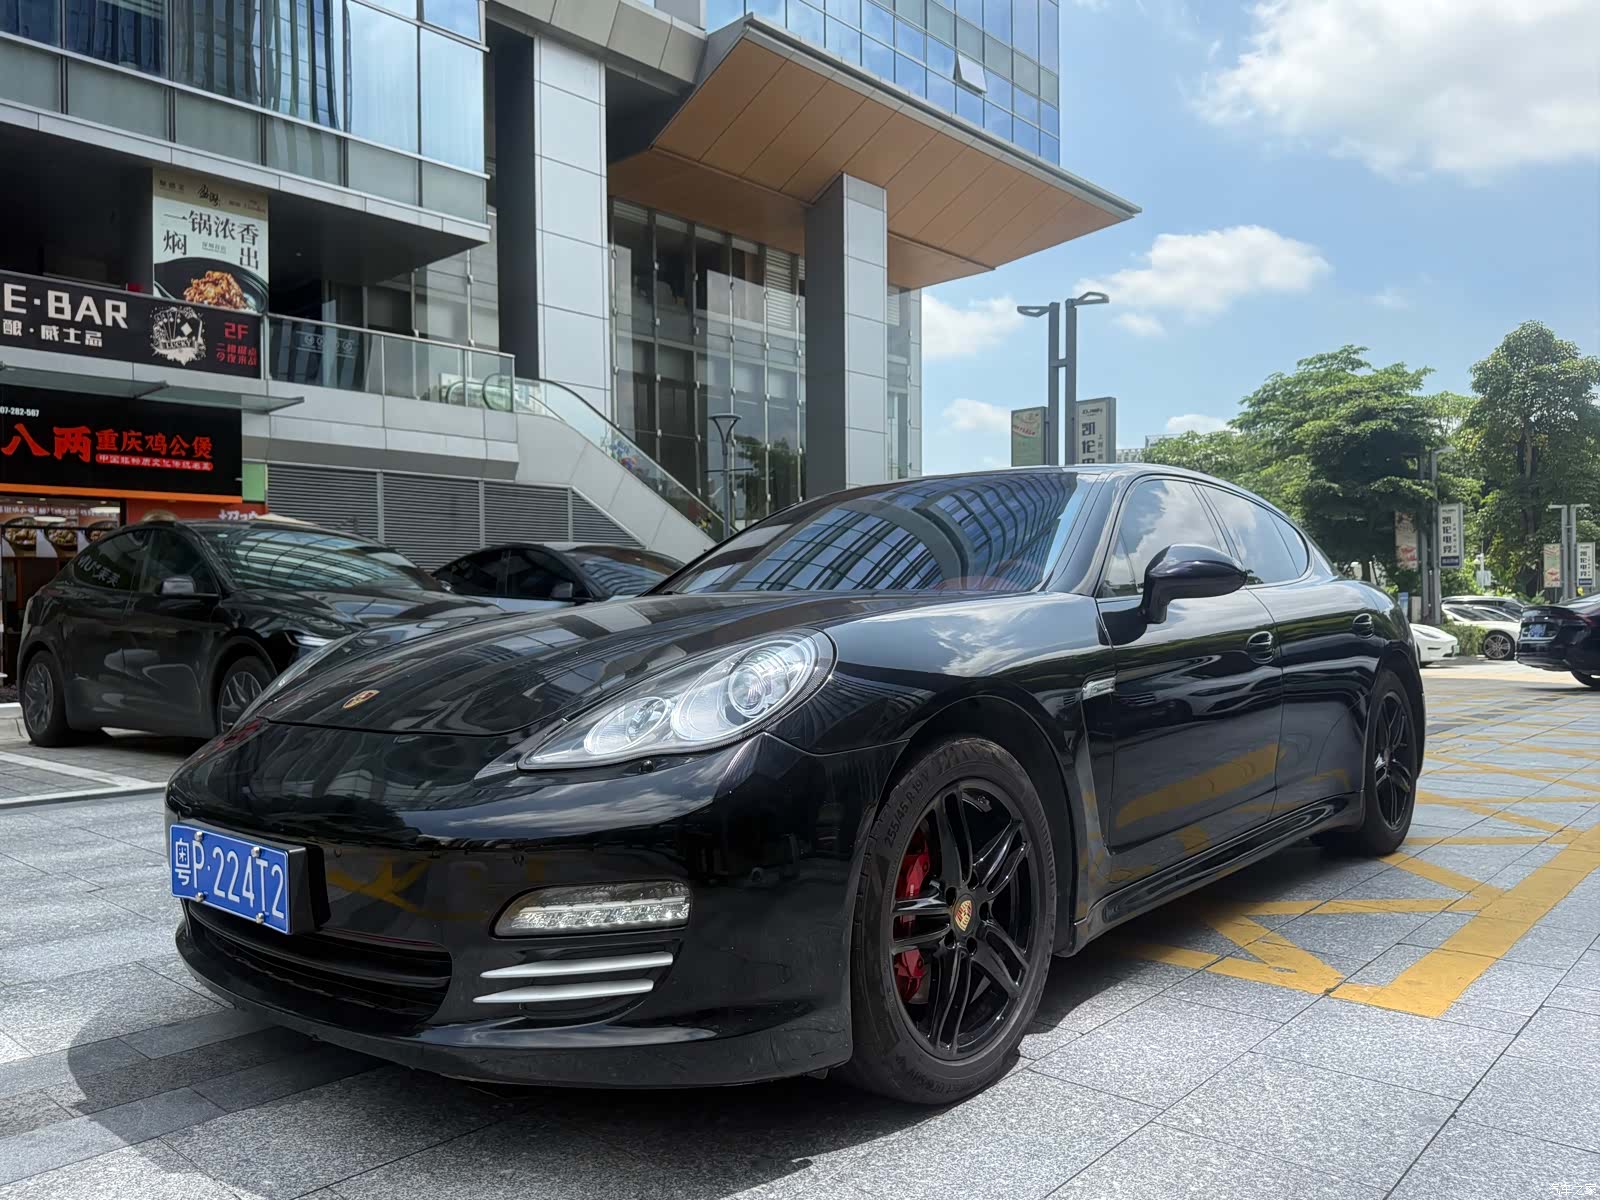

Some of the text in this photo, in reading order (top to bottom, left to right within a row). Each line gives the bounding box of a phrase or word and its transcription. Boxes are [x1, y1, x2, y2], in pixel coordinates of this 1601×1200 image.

[163, 210, 259, 246] 一锅浓香
[163, 229, 187, 256] 焖
[239, 247, 259, 271] 出
[223, 322, 249, 341] 2F
[95, 428, 213, 460] 重庆鸡公煲
[884, 802, 909, 849] 255/45
